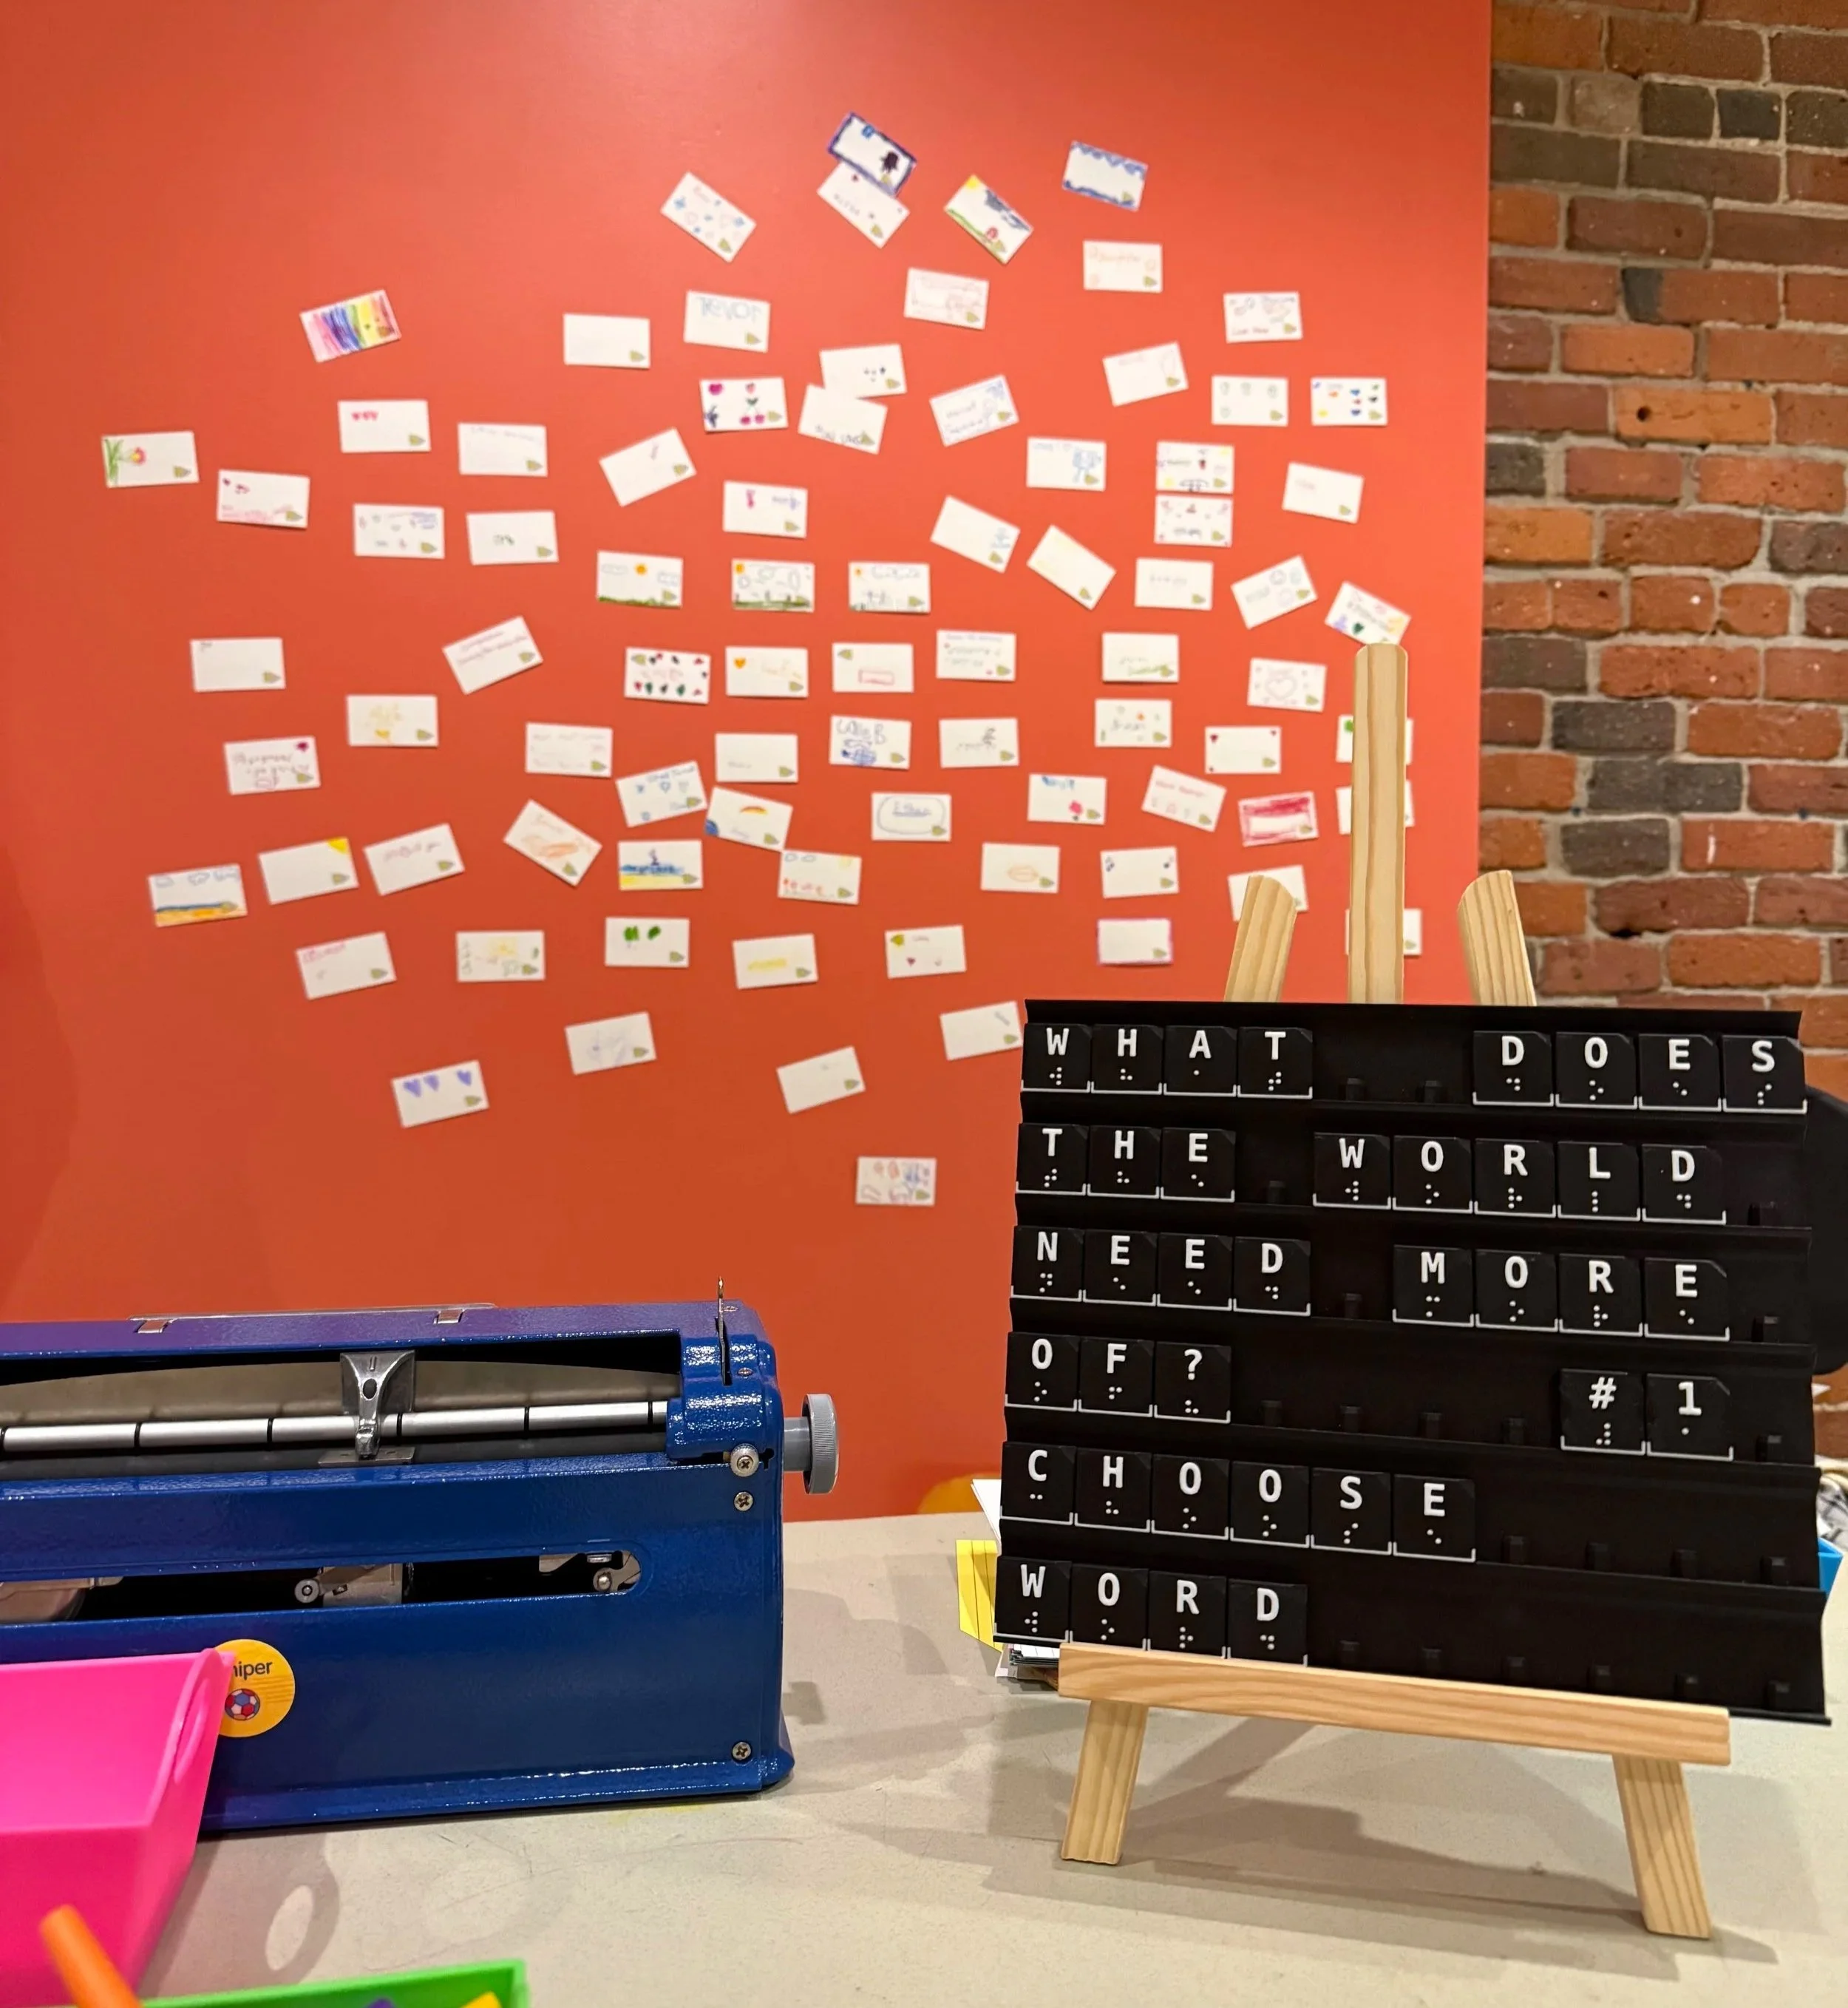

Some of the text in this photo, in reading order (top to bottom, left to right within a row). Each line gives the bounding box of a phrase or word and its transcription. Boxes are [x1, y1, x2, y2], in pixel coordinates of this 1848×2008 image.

[1046, 1027, 1775, 1072] WHAT DOES
[1042, 1127, 1695, 1181] THE WORLD
[1037, 1231, 1698, 1298] NEED MORE
[1031, 1338, 1702, 1416] OF? #1
[1028, 1449, 1445, 1517] CHOOSE
[1020, 1564, 1280, 1621] WORD
